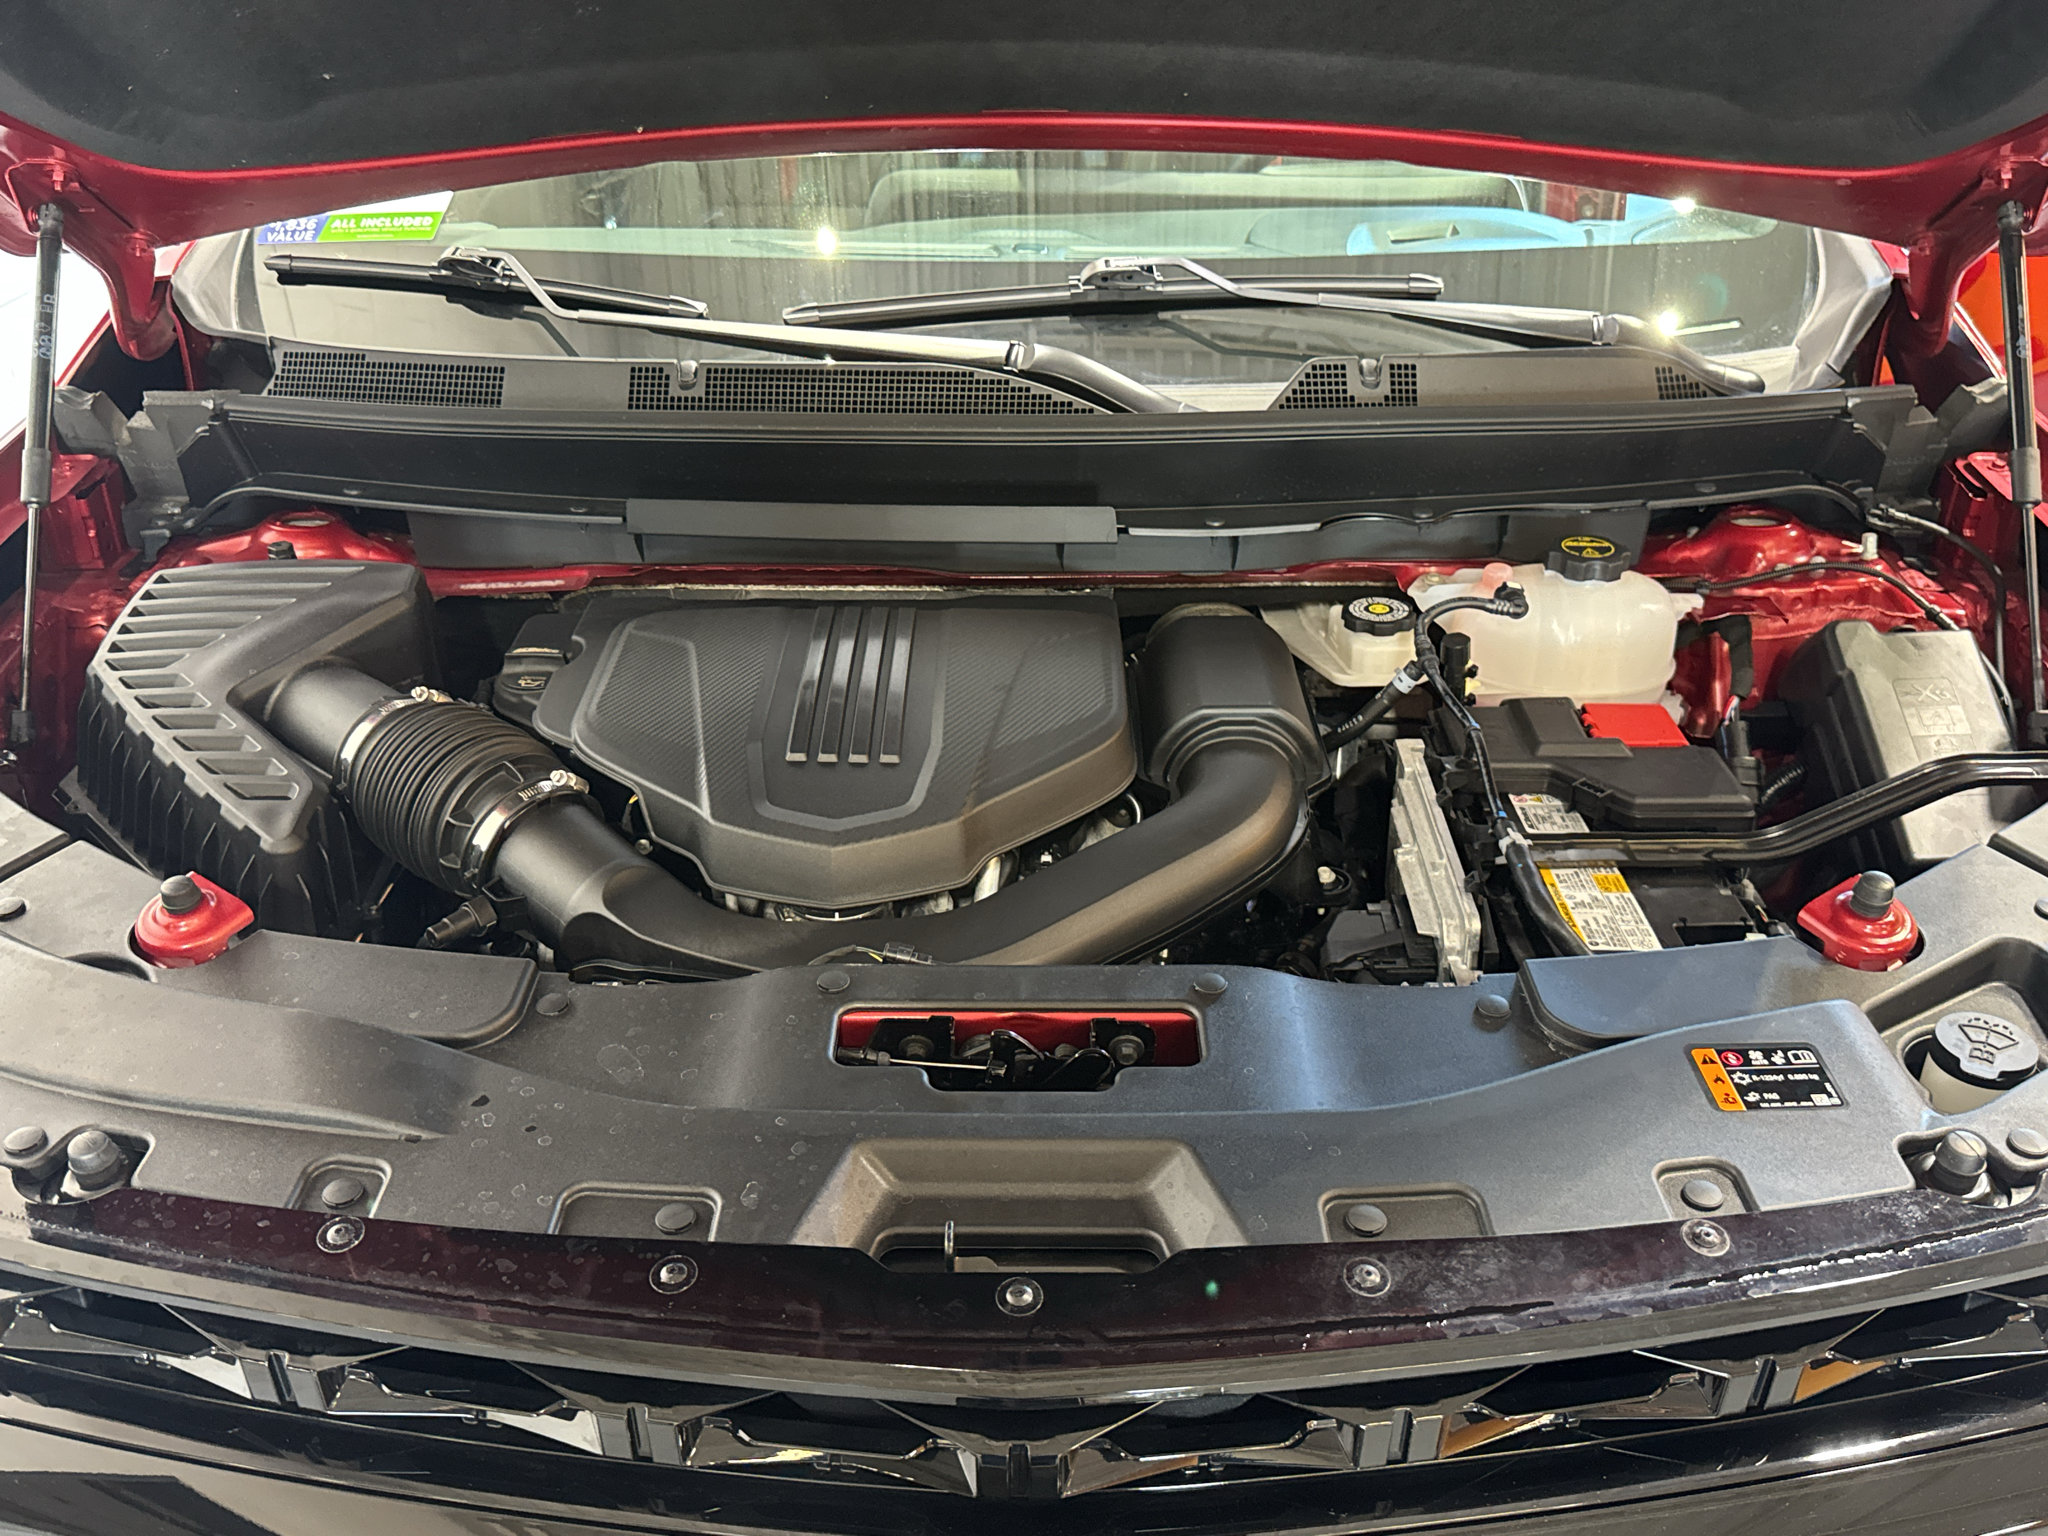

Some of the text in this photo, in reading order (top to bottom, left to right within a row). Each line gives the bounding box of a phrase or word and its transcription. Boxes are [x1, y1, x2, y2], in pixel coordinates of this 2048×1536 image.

[330, 217, 433, 228] ALL INCLUDED
[267, 230, 316, 242] VALUE
